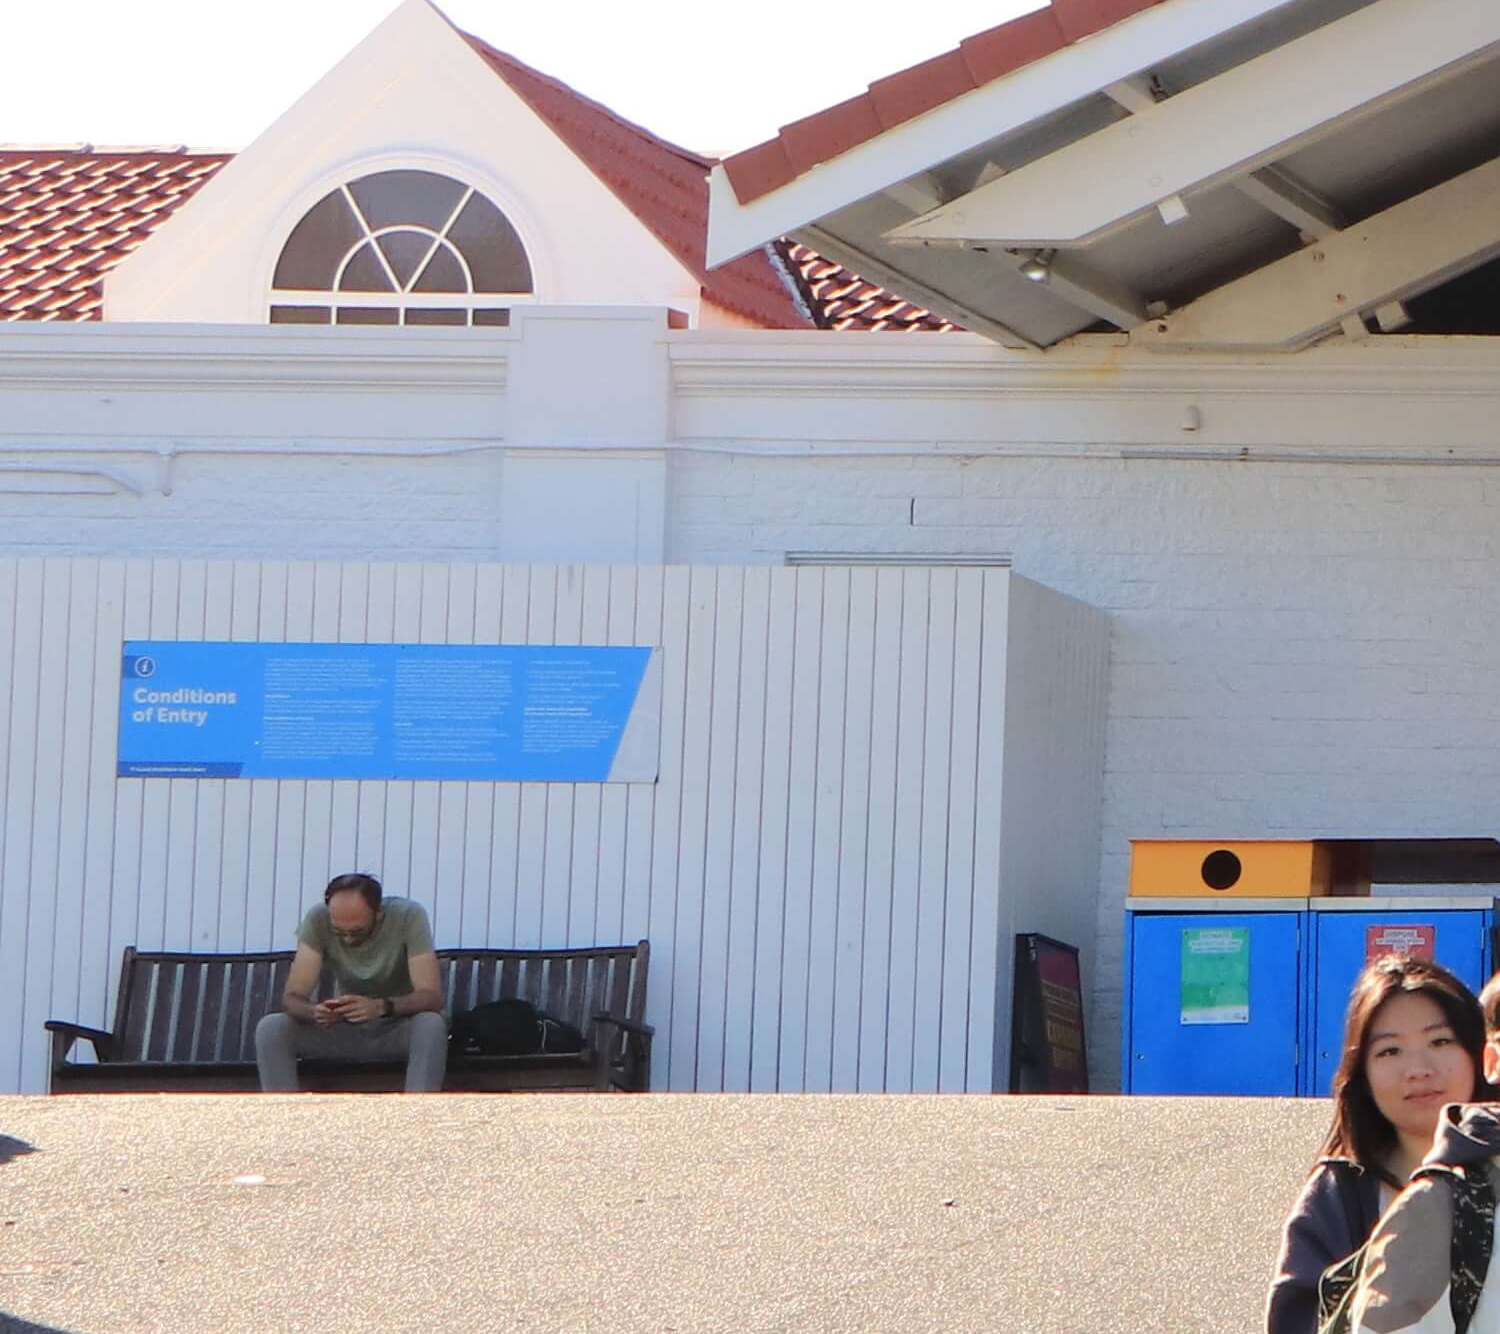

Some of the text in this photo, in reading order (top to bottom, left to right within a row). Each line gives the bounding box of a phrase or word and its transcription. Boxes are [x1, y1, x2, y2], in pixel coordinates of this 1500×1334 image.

[132, 687, 237, 706] Conditions
[132, 706, 208, 726] of Entry
